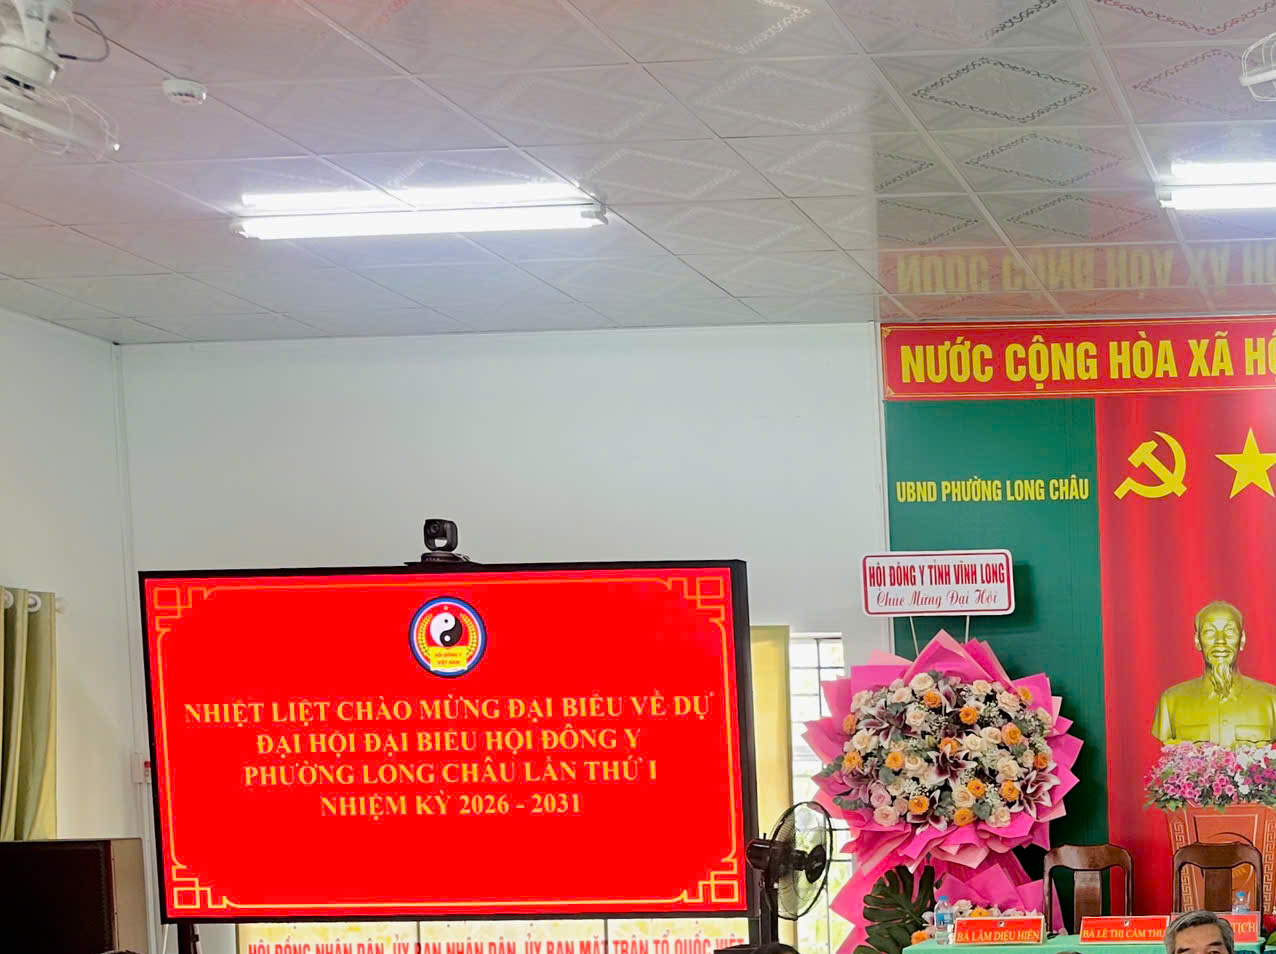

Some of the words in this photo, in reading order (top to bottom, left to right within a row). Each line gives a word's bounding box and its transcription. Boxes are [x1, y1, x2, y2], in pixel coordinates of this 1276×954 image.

[901, 336, 993, 383] NƯỚC
[1005, 335, 1098, 390] CỘNG
[1109, 331, 1177, 379] HÒA
[1188, 330, 1234, 377] XÃ
[896, 481, 936, 502] UBND
[942, 476, 1002, 502] PHƯỜNG
[1007, 480, 1045, 501] LONG
[1050, 475, 1089, 500] CHÂU
[919, 565, 925, 585] Y
[980, 563, 1005, 584] LONG
[184, 699, 264, 727] NHIỆT
[272, 699, 330, 726] LIỆT
[337, 696, 412, 721] CHÀO
[419, 694, 500, 719] MỪNG
[508, 697, 552, 723] ĐẠI
[630, 691, 666, 716] VỀ
[674, 692, 715, 720] DỰ
[257, 733, 301, 758] ĐẠI
[309, 731, 355, 758] HỘI
[365, 732, 408, 757] ĐẠI
[486, 727, 532, 755] HỘI
[542, 723, 616, 750] ĐÔNG
[624, 728, 640, 749] Y
[245, 761, 353, 786] PHƯỜNG
[362, 763, 435, 784] LONG
[442, 756, 515, 783] CHÂU
[584, 755, 643, 781] THỨ
[649, 760, 657, 780] I
[321, 793, 407, 821] NHIỆM
[416, 790, 449, 815] KỲ
[459, 794, 509, 815] 2026
[530, 793, 580, 814] 2031
